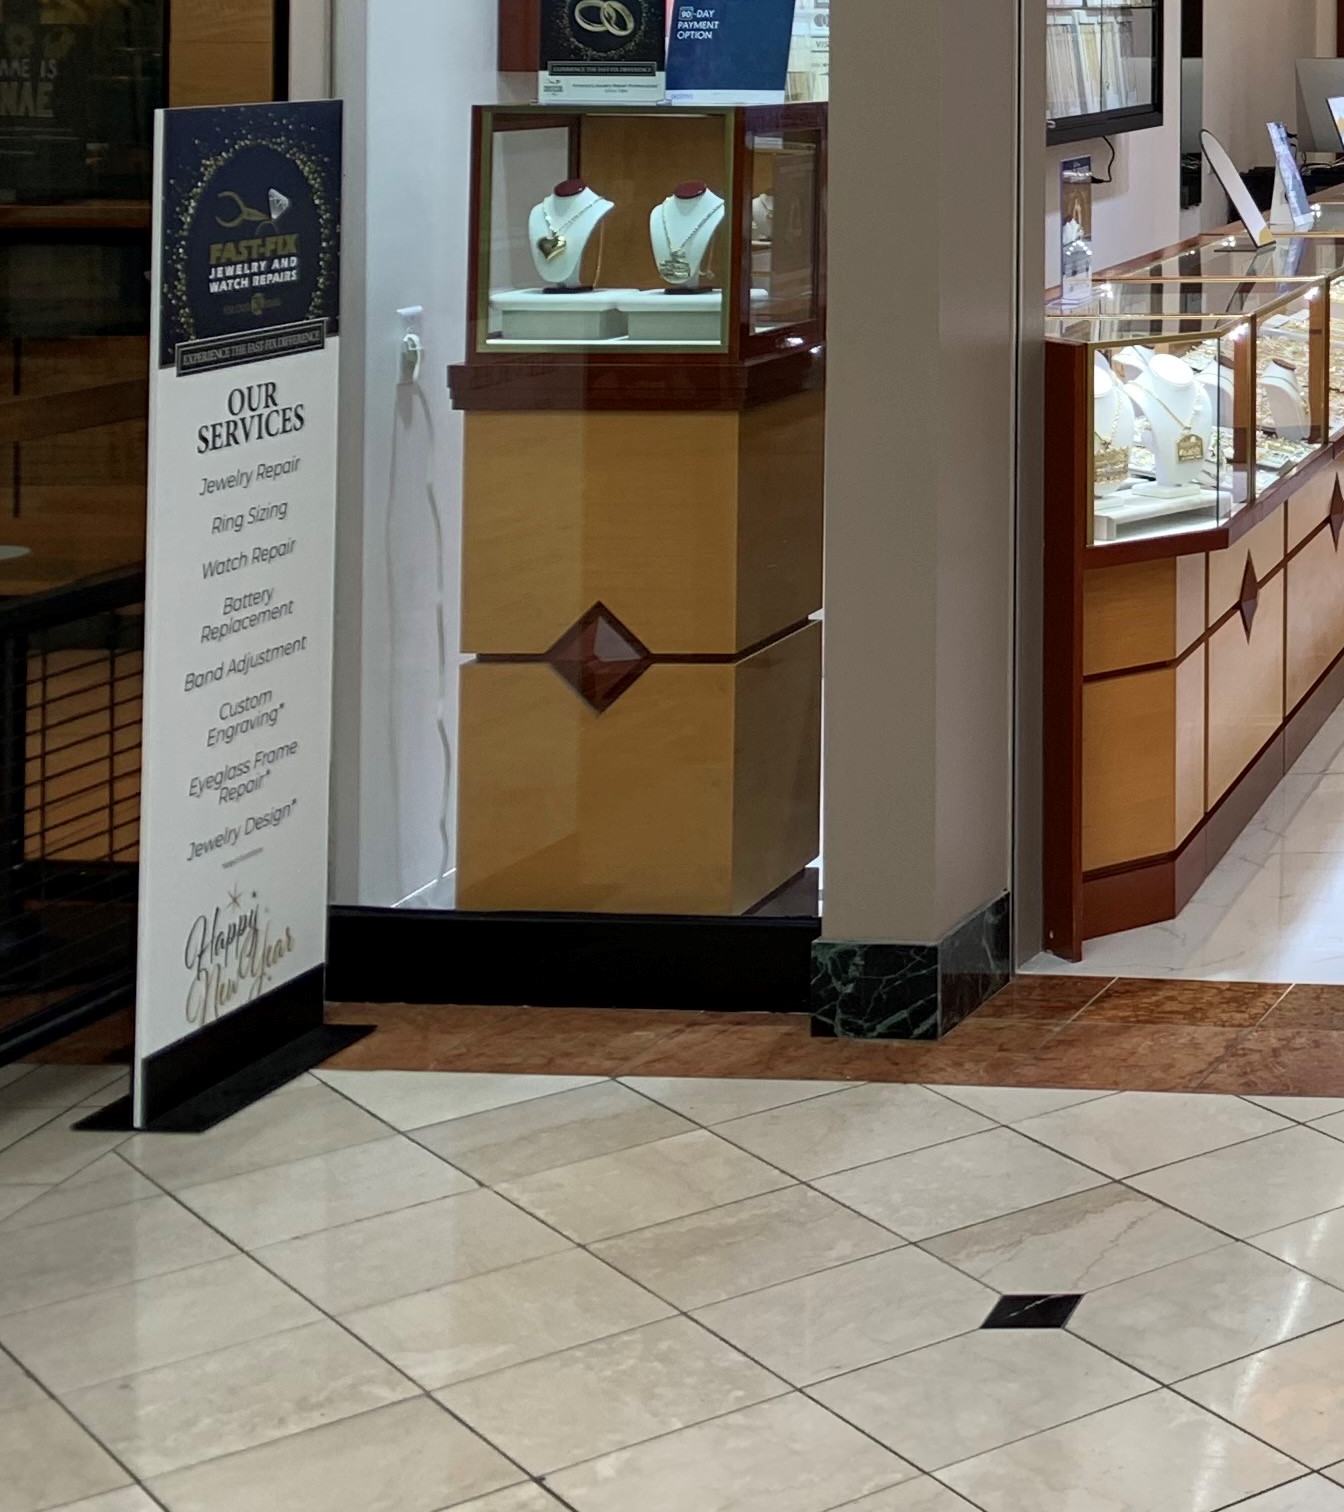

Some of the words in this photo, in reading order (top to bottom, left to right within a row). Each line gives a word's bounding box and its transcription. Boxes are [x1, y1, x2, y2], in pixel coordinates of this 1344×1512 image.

[677, 20, 719, 30] PAYMENT
[677, 30, 713, 40] OPTION
[209, 233, 299, 264] FAST-FIX
[208, 261, 266, 278] JEWELRY
[272, 256, 298, 269] AND
[208, 277, 249, 294] WATCH
[252, 269, 298, 287] REPAIRS
[227, 381, 278, 416] OUR
[197, 403, 305, 454] SERVICES
[198, 469, 252, 496] Jewelry
[256, 455, 301, 482] Repair
[211, 516, 244, 536] Ring
[247, 500, 288, 524] Sizing
[202, 552, 248, 580] Watch
[252, 537, 297, 567] Repair
[222, 587, 274, 616] Battery
[201, 599, 294, 645] Replacement
[184, 669, 224, 692] Band
[227, 635, 307, 677] Adjustment
[219, 690, 273, 721] Custom
[189, 757, 251, 798] Eyeglass
[253, 739, 298, 770] Frame
[186, 825, 240, 862] Jewelry
[184, 904, 259, 978] Happy
